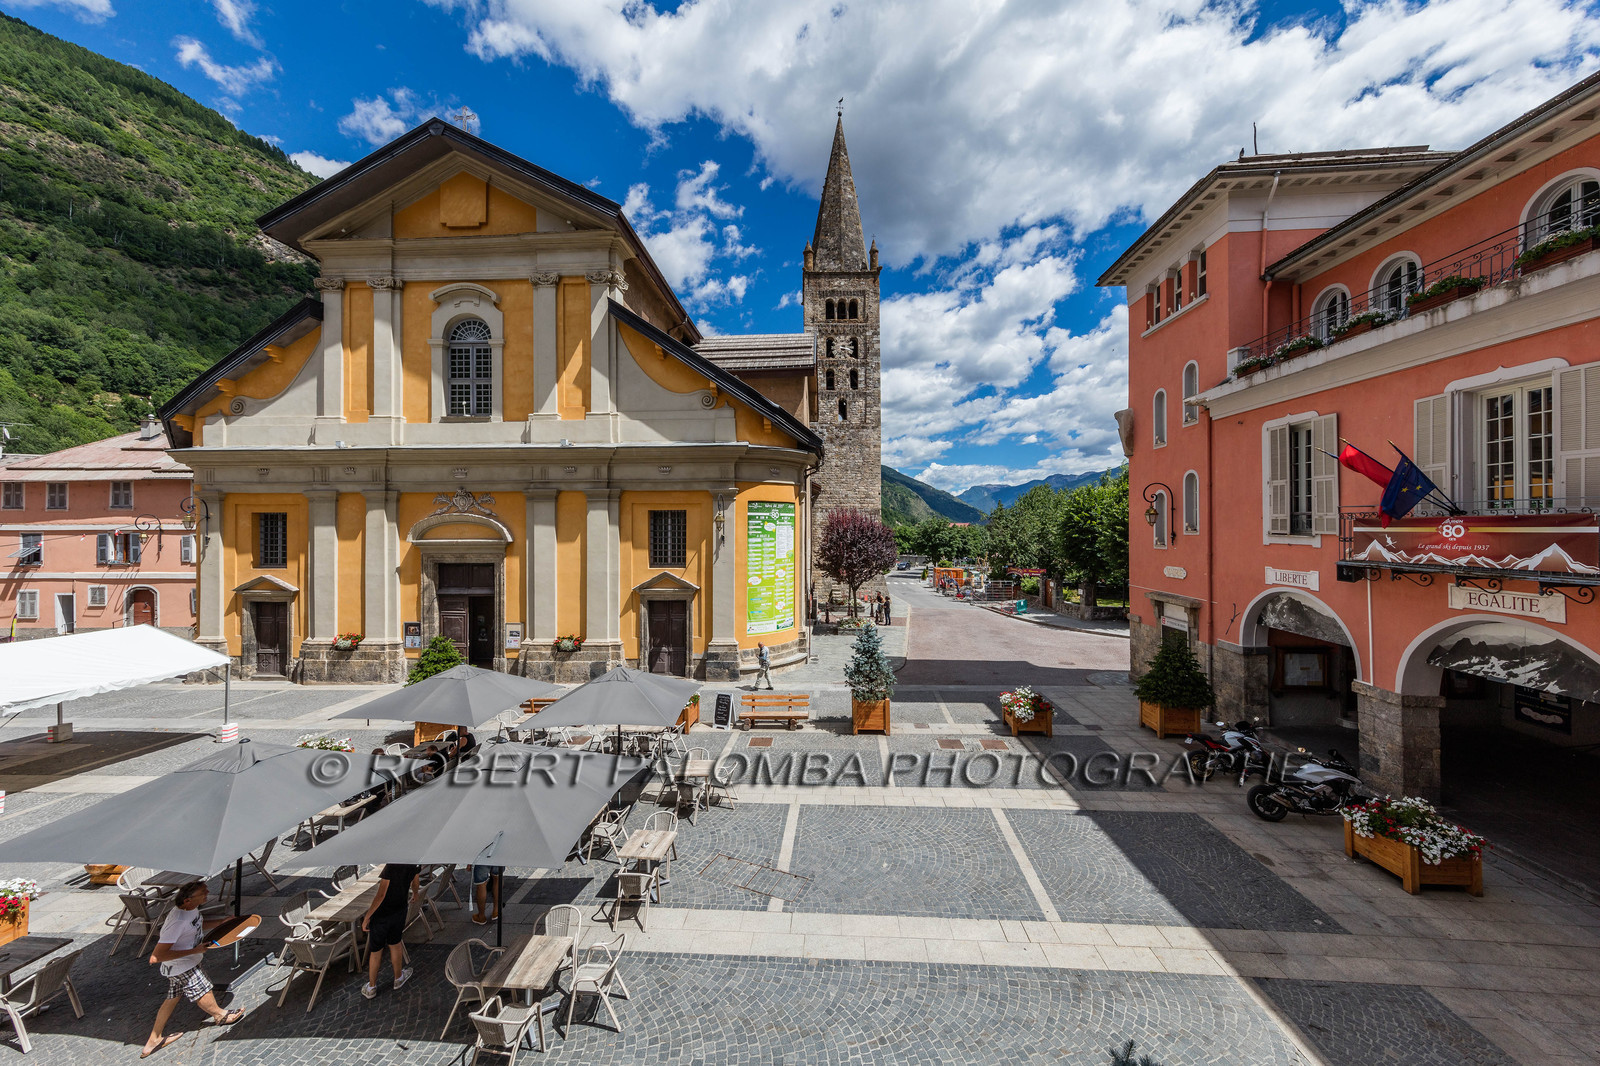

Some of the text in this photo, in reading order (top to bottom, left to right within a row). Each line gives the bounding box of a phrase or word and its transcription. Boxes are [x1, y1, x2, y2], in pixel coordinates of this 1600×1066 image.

[1442, 524, 1465, 538] 80
[1452, 543, 1472, 551] depuis
[1274, 571, 1308, 585] LIBERTE
[1468, 592, 1540, 613] EGALITE
